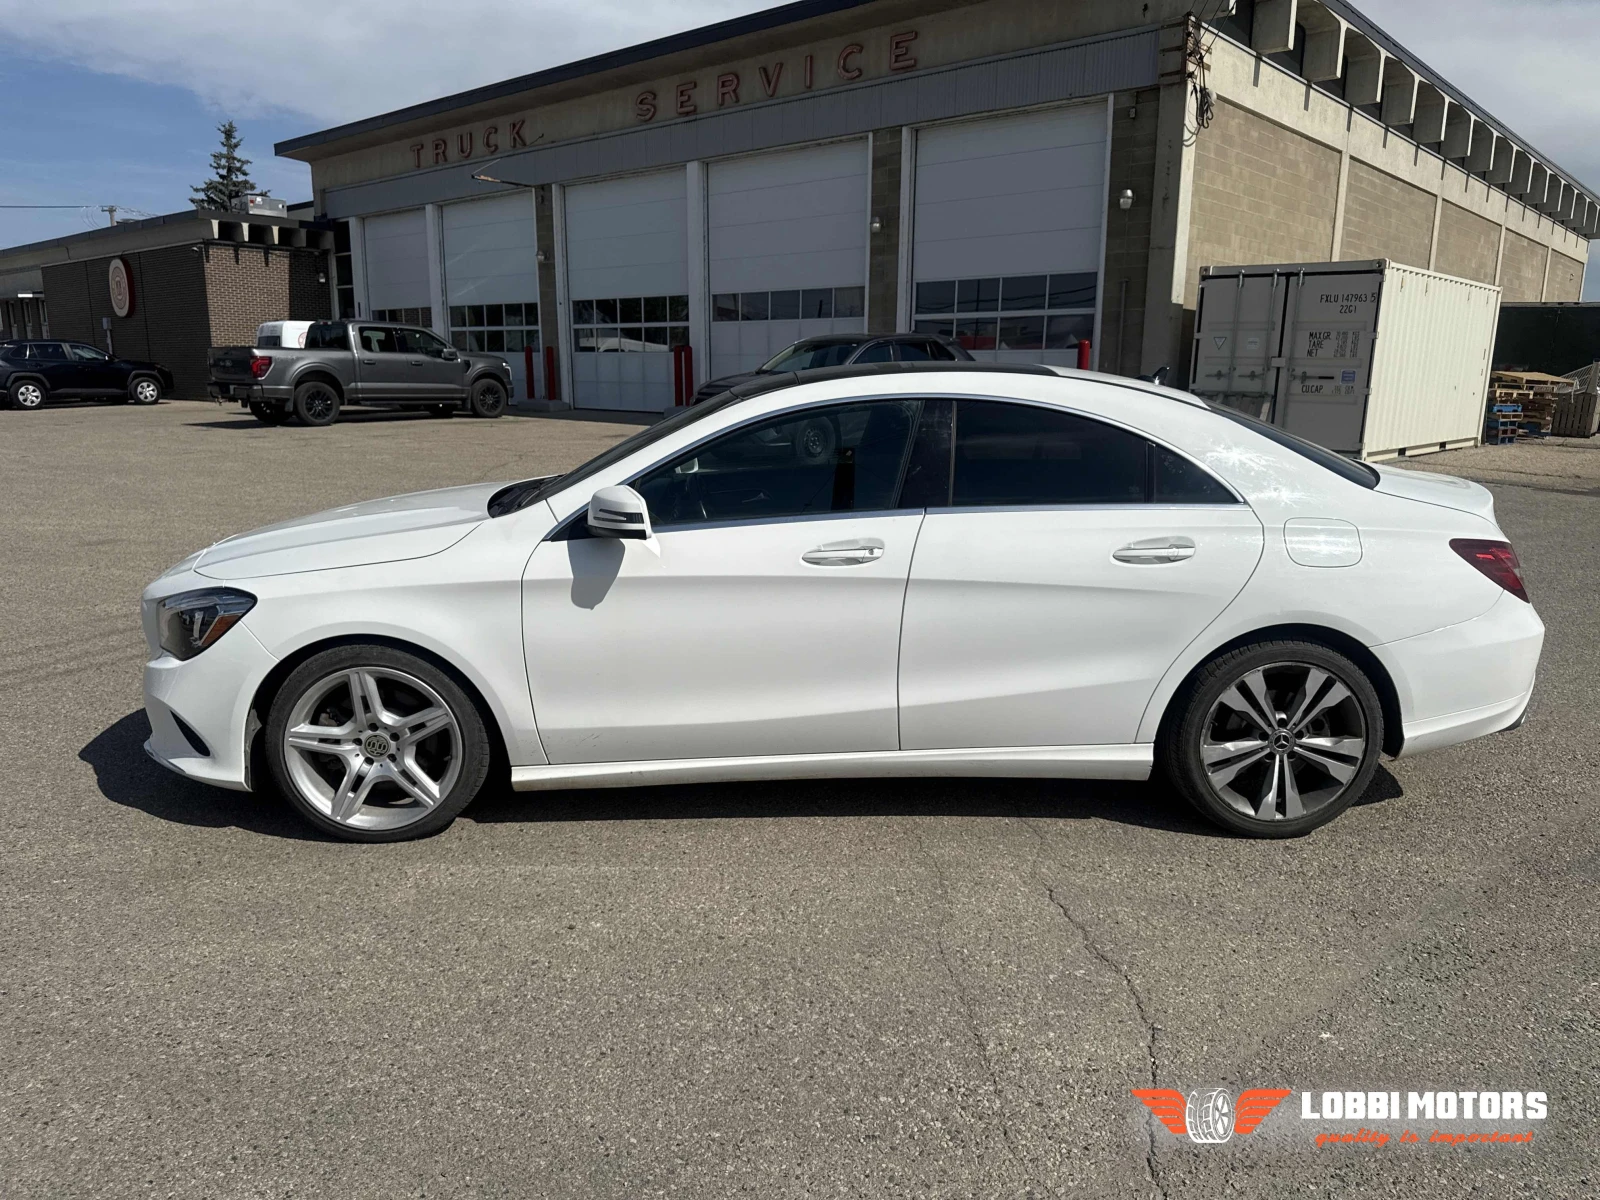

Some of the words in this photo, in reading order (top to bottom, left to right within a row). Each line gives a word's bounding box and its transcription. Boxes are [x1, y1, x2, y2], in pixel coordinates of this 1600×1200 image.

[410, 119, 527, 168] TRUCK
[636, 30, 918, 122] SERVICE
[1320, 294, 1339, 303] FXLU
[1341, 293, 1368, 303] 147963
[1370, 292, 1377, 303] 5
[1339, 305, 1357, 314] 22G1
[1308, 340, 1324, 349] TARE
[1307, 349, 1319, 357] NET
